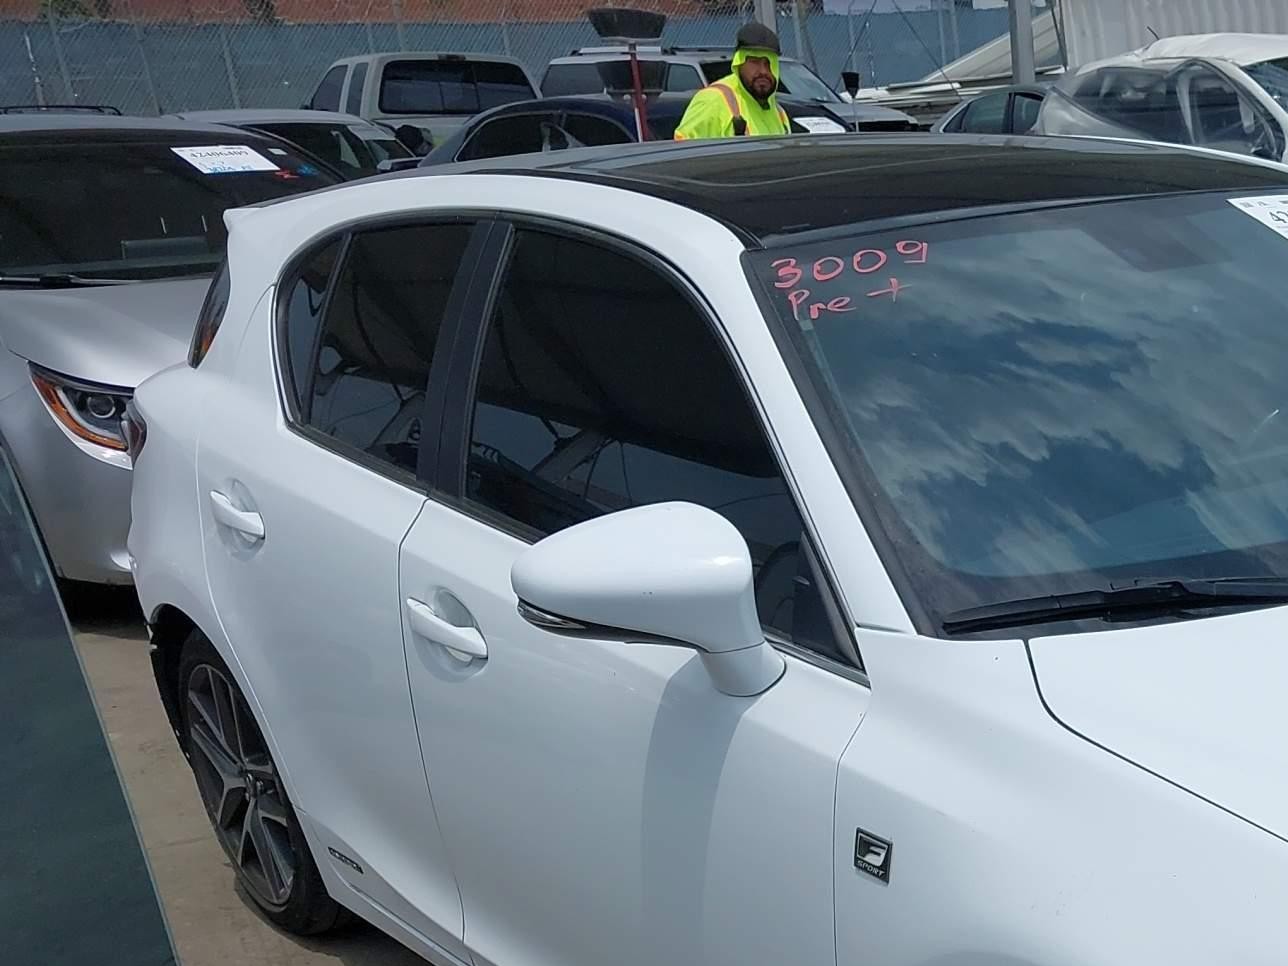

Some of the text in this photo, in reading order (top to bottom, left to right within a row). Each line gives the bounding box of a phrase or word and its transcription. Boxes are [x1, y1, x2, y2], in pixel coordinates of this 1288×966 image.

[771, 240, 928, 288] 3009
[788, 289, 857, 320] Pre
[857, 860, 886, 877] SPORT
